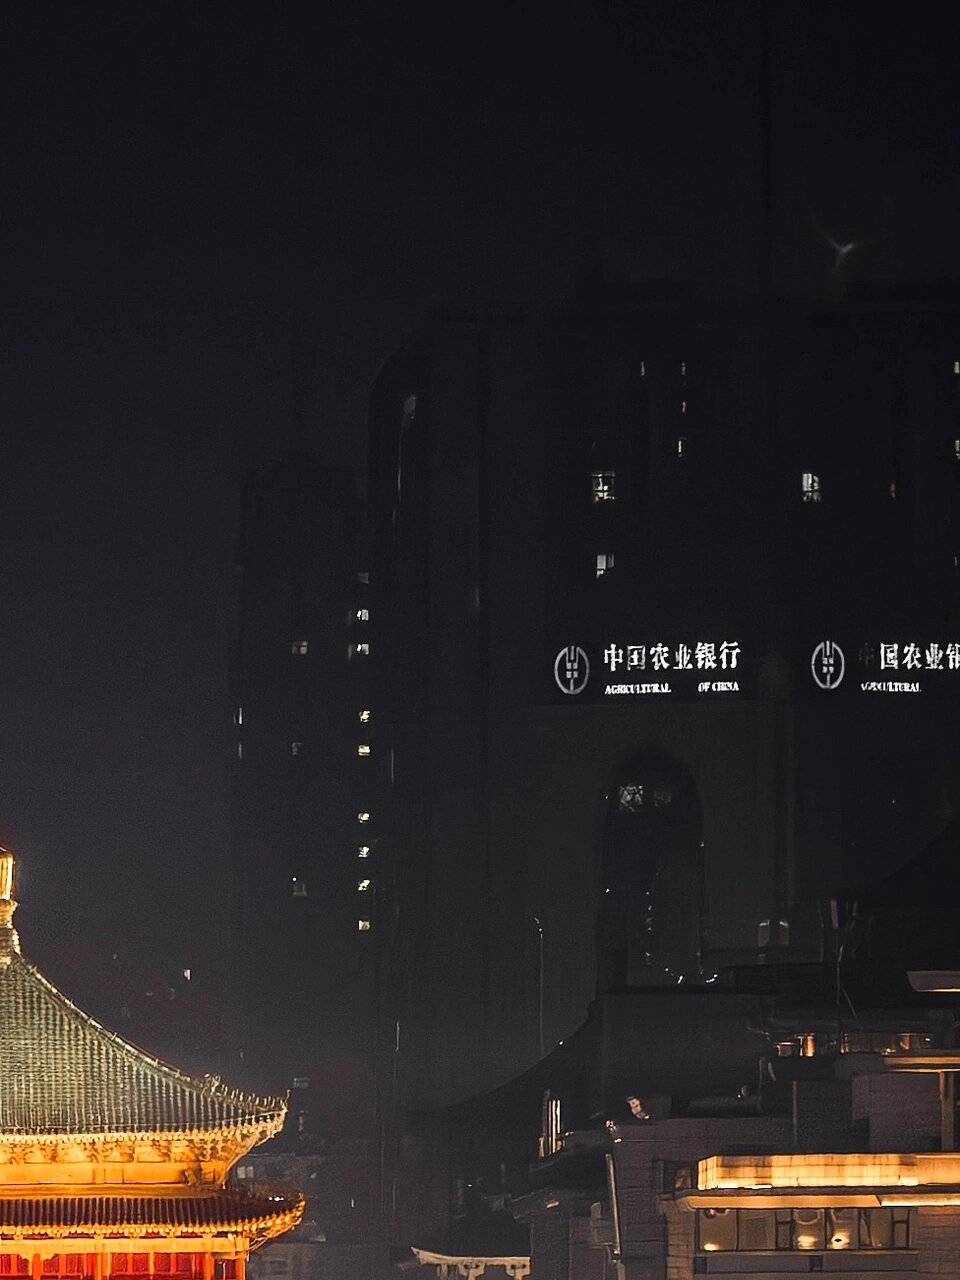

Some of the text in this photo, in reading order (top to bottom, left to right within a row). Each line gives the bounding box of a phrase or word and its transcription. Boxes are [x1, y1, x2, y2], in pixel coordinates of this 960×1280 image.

[604, 641, 741, 672] 中国农业银行
[697, 682, 711, 692] OF
[712, 681, 740, 692] CHINA
